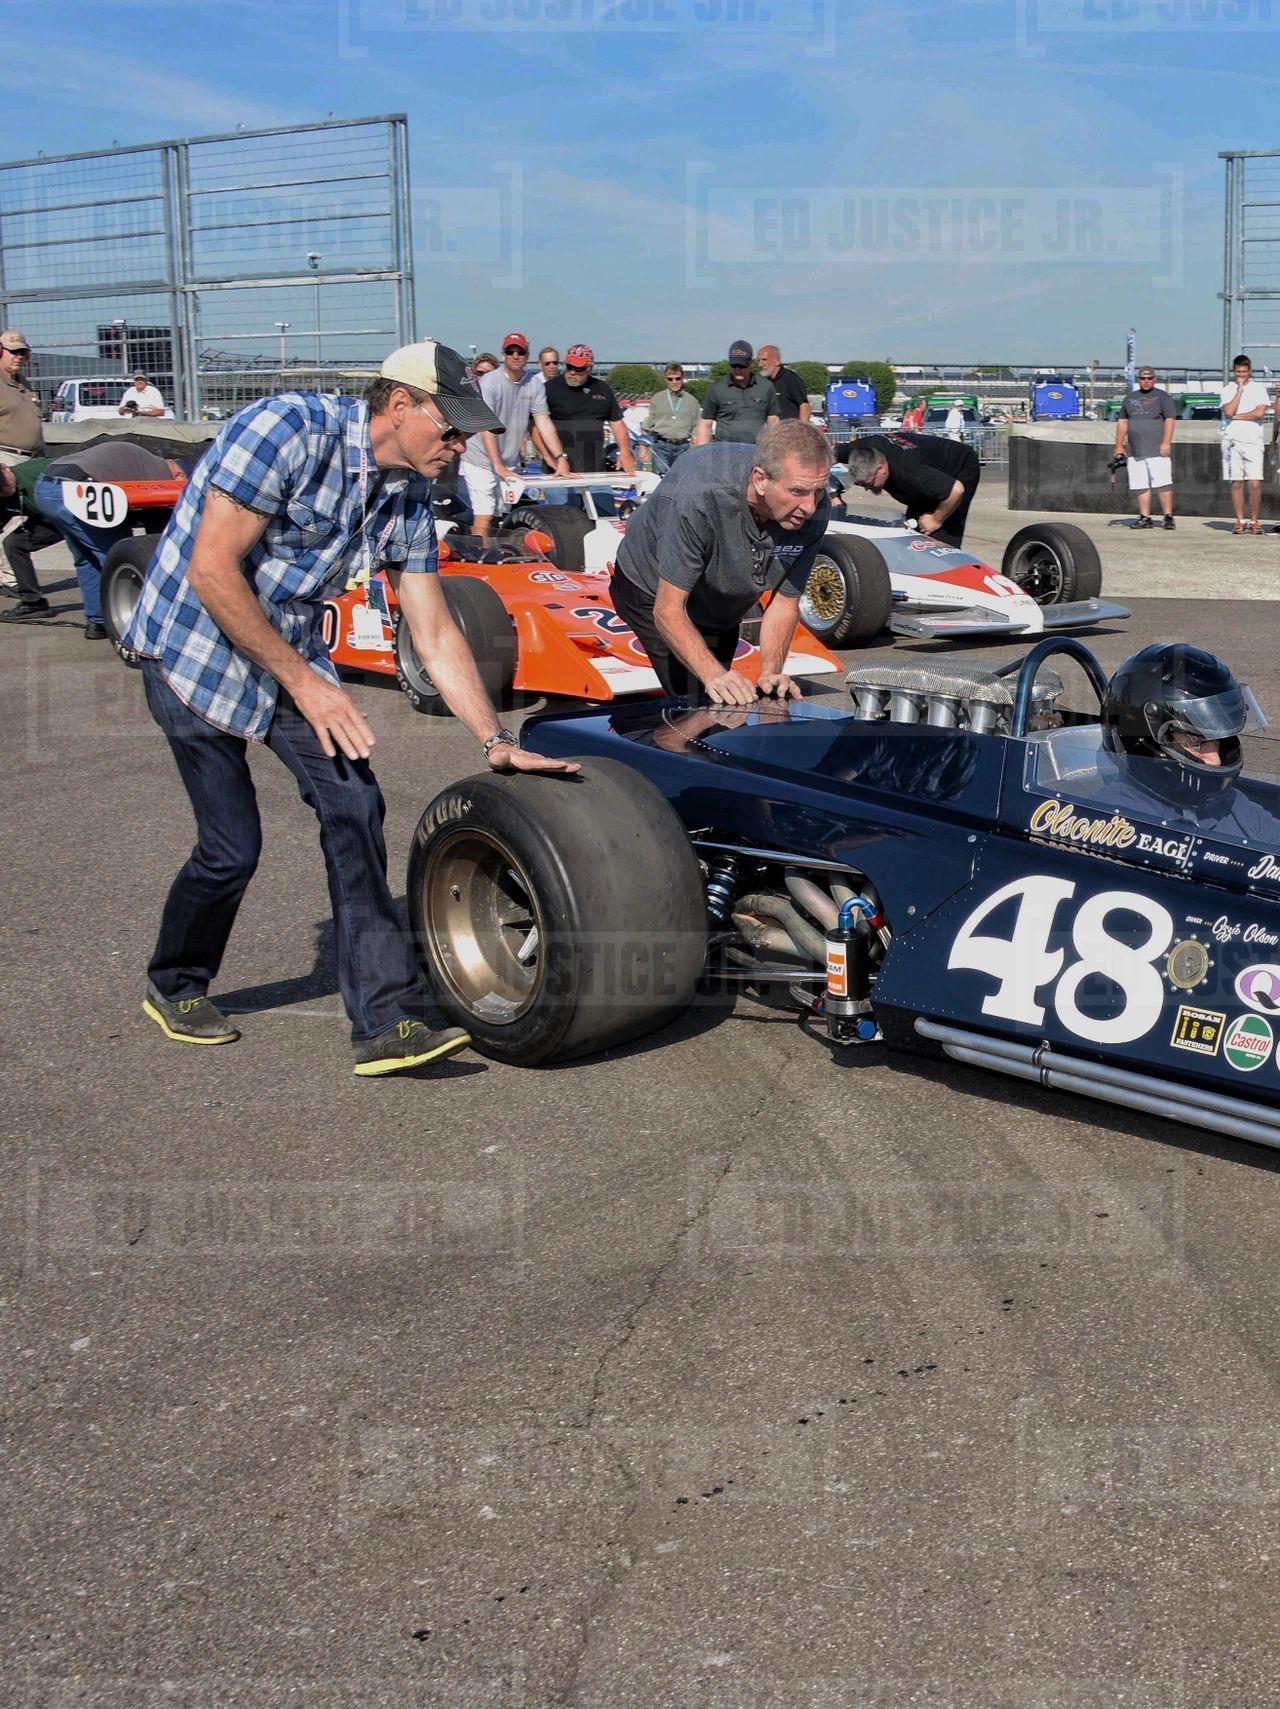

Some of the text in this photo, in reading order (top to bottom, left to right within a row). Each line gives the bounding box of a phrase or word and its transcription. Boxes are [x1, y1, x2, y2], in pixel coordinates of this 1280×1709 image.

[85, 485, 115, 523] 20
[983, 574, 1025, 597] 19
[1030, 799, 1138, 848] Olsonite
[1203, 852, 1229, 865] DRIVER
[1212, 915, 1241, 943] Ozzie
[1243, 923, 1279, 946] Olson
[947, 875, 1174, 1044] 48
[1175, 1038, 1214, 1052] FASTENERS
[1231, 1032, 1270, 1054] Castrol
